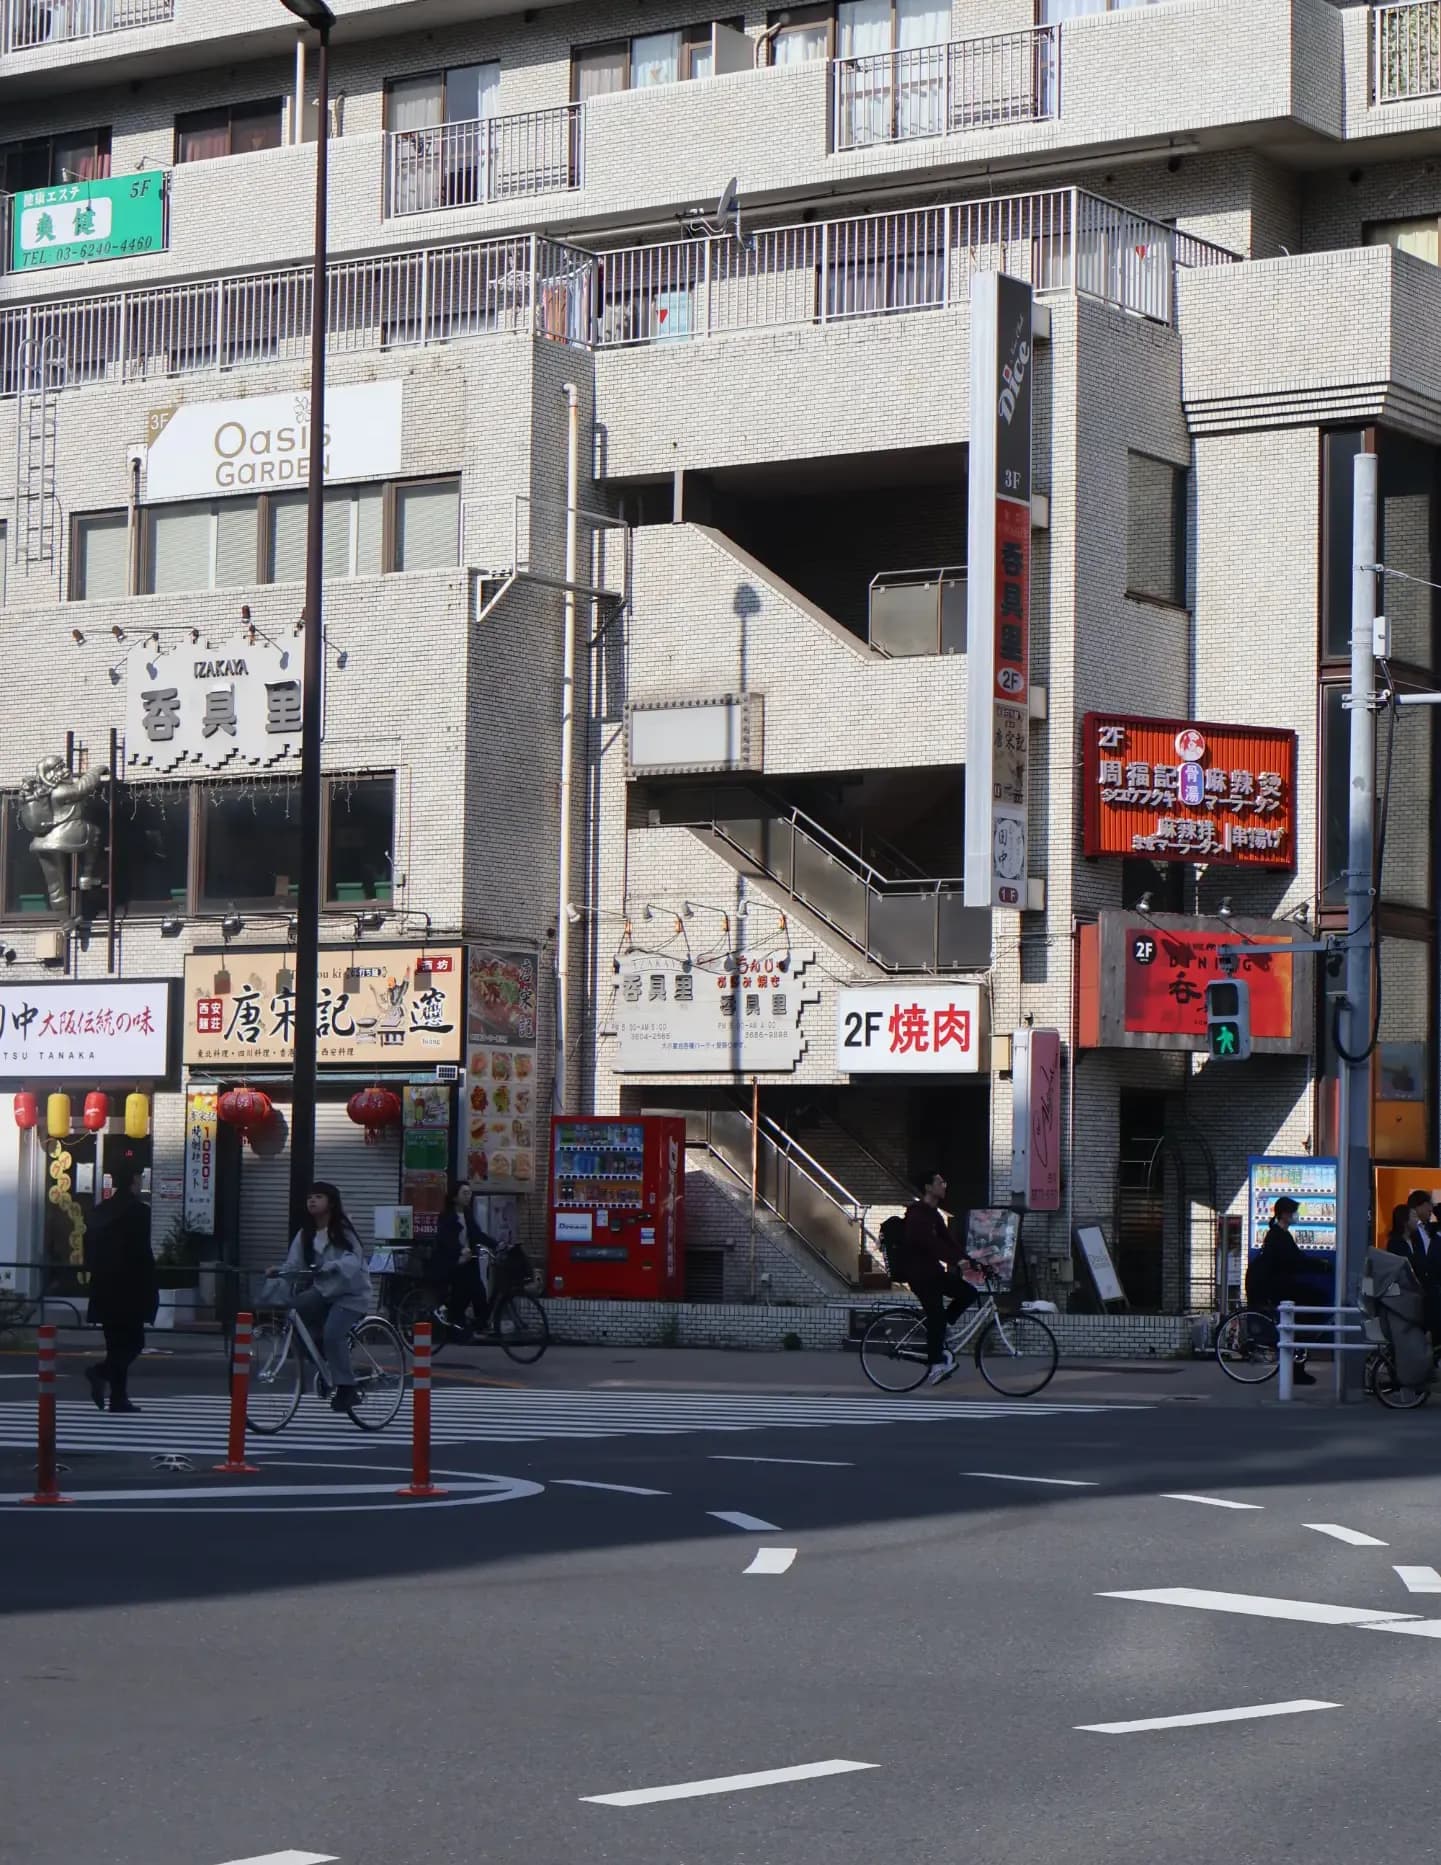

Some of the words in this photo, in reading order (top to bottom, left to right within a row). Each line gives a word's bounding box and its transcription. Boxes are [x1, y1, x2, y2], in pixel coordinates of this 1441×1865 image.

[130, 179, 151, 199] 5F
[23, 251, 47, 266] TEL
[56, 235, 153, 261] 03-6240-4460
[151, 413, 169, 431] 3F
[1005, 469, 1022, 490] 3F
[194, 658, 249, 679] IZAKAYA
[1002, 670, 1020, 689] 2F
[1098, 726, 1125, 748] 2F
[1098, 759, 1178, 790] 周福記
[1204, 793, 1281, 813] マーラータン
[1231, 825, 1285, 849] 串揚げ
[1135, 942, 1153, 957] 2F
[1169, 956, 1252, 972] DINIG
[199, 1001, 222, 1016] 西安
[0, 1001, 39, 1042] 中
[38, 1004, 156, 1038] 大阪伝統の味
[844, 1012, 884, 1047] 2F
[888, 1003, 971, 1054] 焼肉
[39, 1050, 96, 1060] TANAKA
